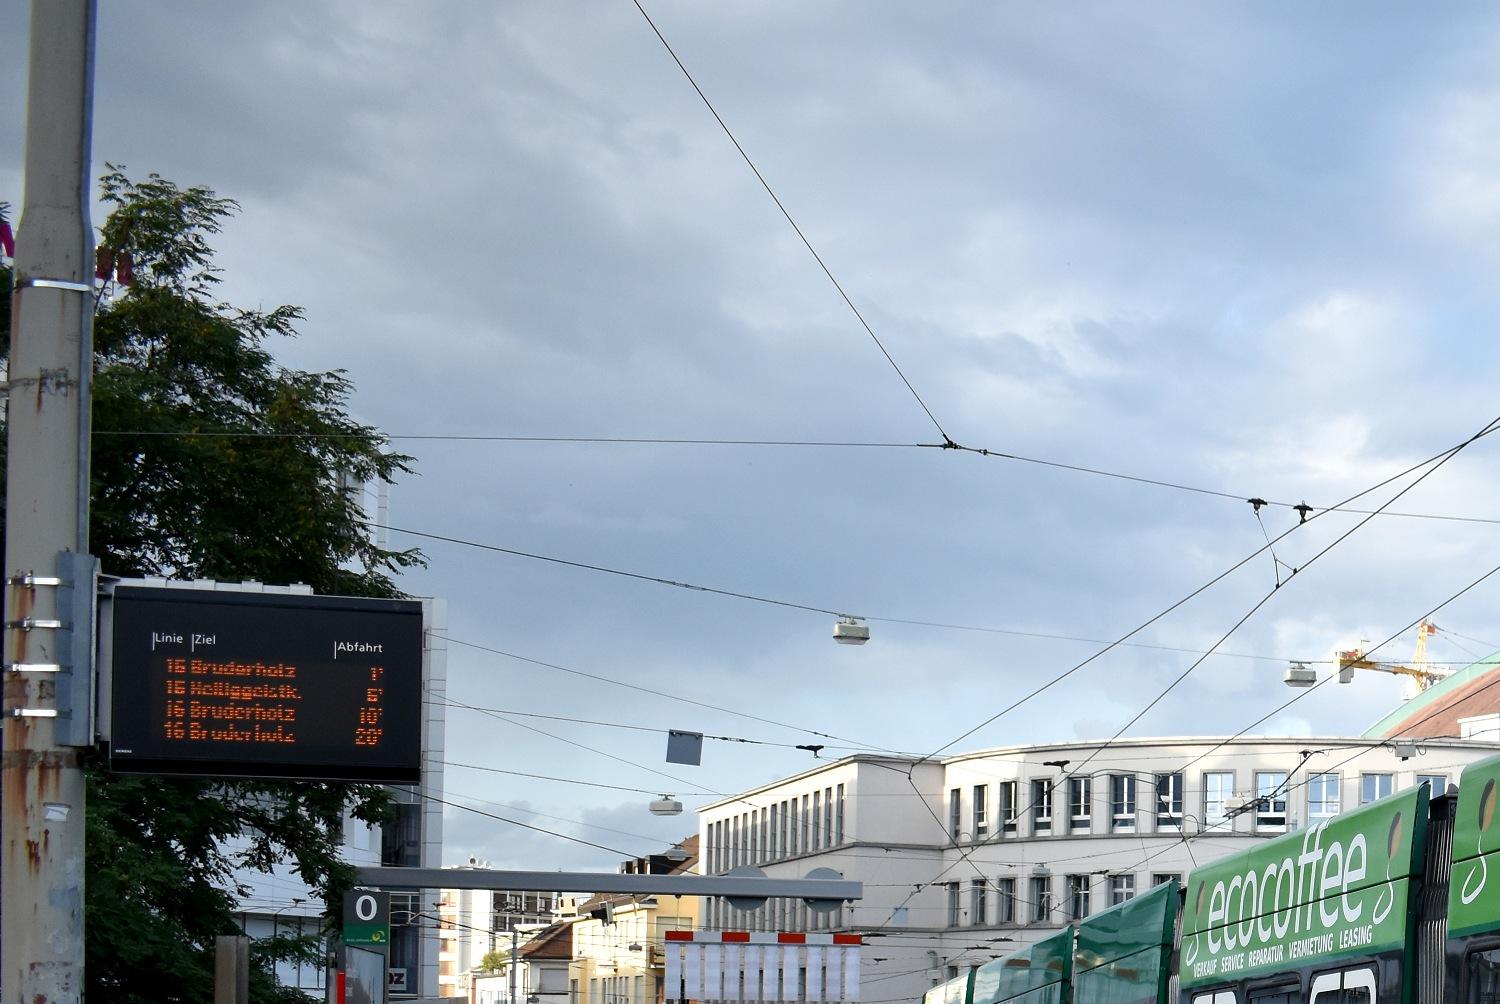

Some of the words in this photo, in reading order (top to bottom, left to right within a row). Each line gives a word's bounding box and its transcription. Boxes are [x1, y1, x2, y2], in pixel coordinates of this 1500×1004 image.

[154, 632, 184, 644] Linie
[194, 634, 217, 646] Ziel
[336, 641, 383, 654] Abfahrt
[166, 659, 186, 673] 16
[190, 660, 297, 678] Bruderholz
[166, 681, 186, 694] 16
[166, 700, 186, 717] 16
[190, 701, 296, 721] Bruderholz
[163, 722, 186, 739] 16
[1206, 815, 1367, 955] ecocoffee
[1193, 959, 1218, 978] VERKAUF
[1220, 952, 1244, 971] SERVICE
[1248, 944, 1284, 968] REPARATUR
[1288, 933, 1334, 959] VERMIETUNG
[1339, 924, 1373, 950] LEASING
